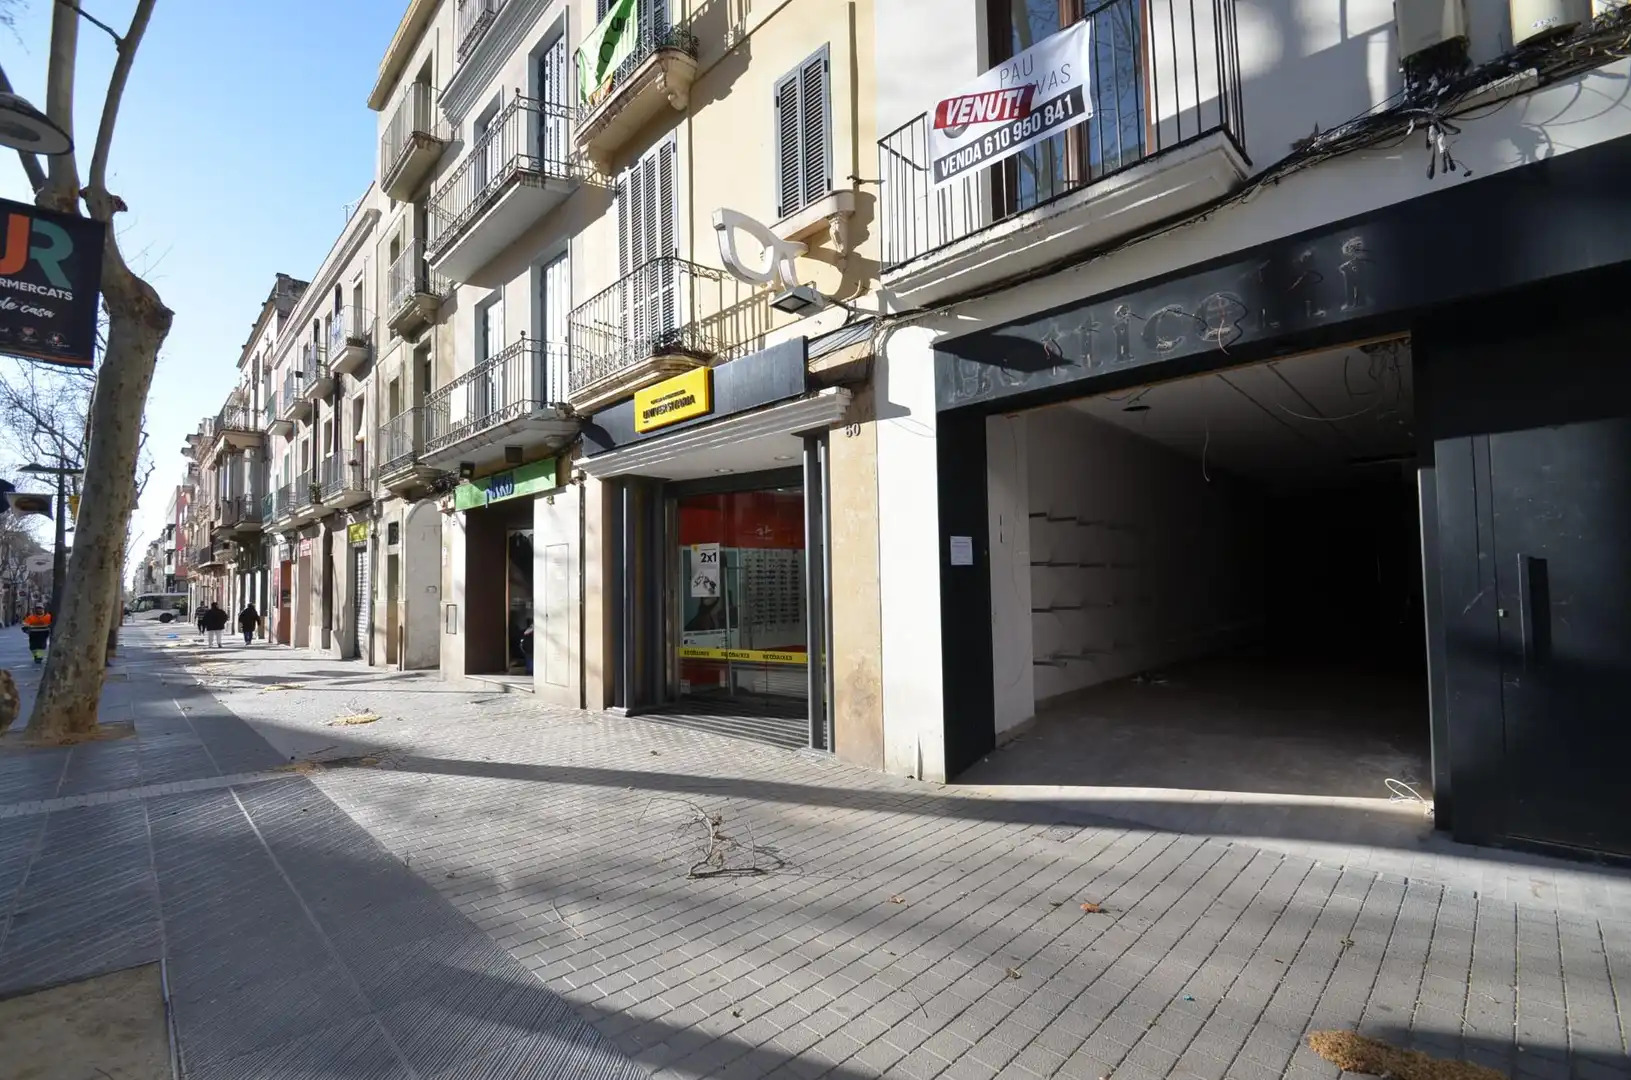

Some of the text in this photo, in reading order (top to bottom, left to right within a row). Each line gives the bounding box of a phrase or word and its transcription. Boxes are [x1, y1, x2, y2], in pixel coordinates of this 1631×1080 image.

[1000, 54, 1034, 88] PAU
[946, 88, 1026, 126] VENUT!
[941, 94, 1073, 177] VENDA 610 950 841
[20, 305, 55, 318] casa
[701, 552, 717, 563] 2x1
